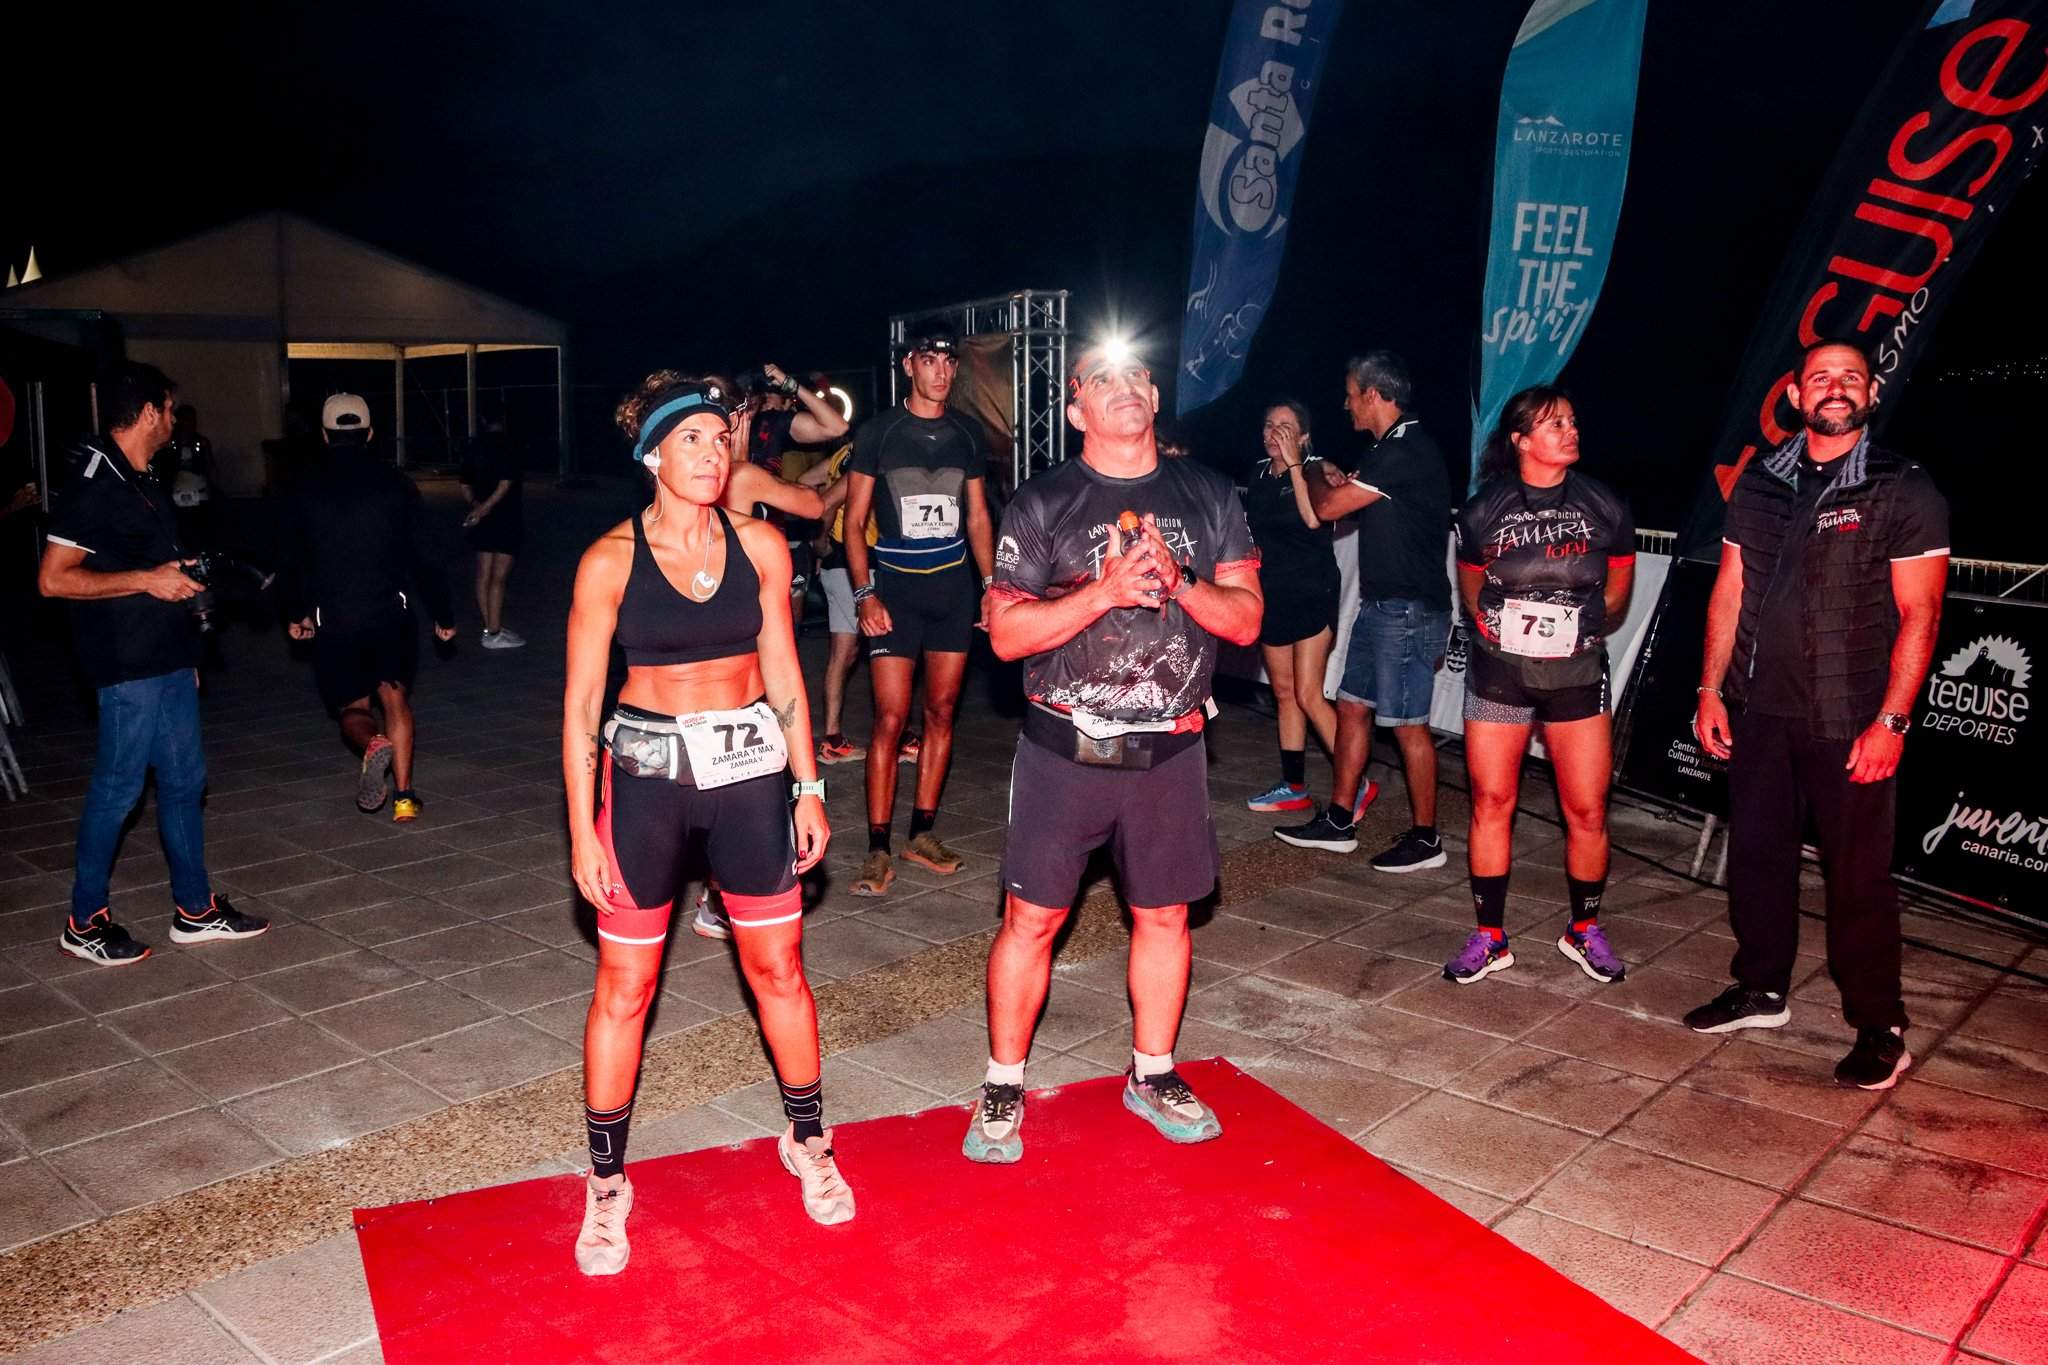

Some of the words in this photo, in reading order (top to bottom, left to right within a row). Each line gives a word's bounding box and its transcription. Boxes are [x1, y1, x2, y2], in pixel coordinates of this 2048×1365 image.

[1230, 60, 1295, 210] Santa
[1514, 128, 1623, 147] LANZAROTE
[1512, 202, 1593, 256] FEEL
[1518, 258, 1583, 308] THE
[1482, 297, 1589, 356] spirit
[919, 505, 944, 522] 71
[1155, 518, 1182, 528] DICION
[1492, 519, 1596, 557] FAMARA
[1521, 614, 1556, 638] 75
[713, 722, 764, 752] 72
[1922, 711, 2017, 745] DEPORTES
[711, 751, 746, 766] ZAMARA
[746, 748, 756, 759] Y
[757, 743, 775, 755] MAX
[1667, 748, 1694, 764] Cultura
[1694, 757, 1700, 767] y
[1672, 739, 1697, 754] Centro
[729, 758, 757, 769] ZAMARA
[1677, 764, 1712, 781] LANZAROTE
